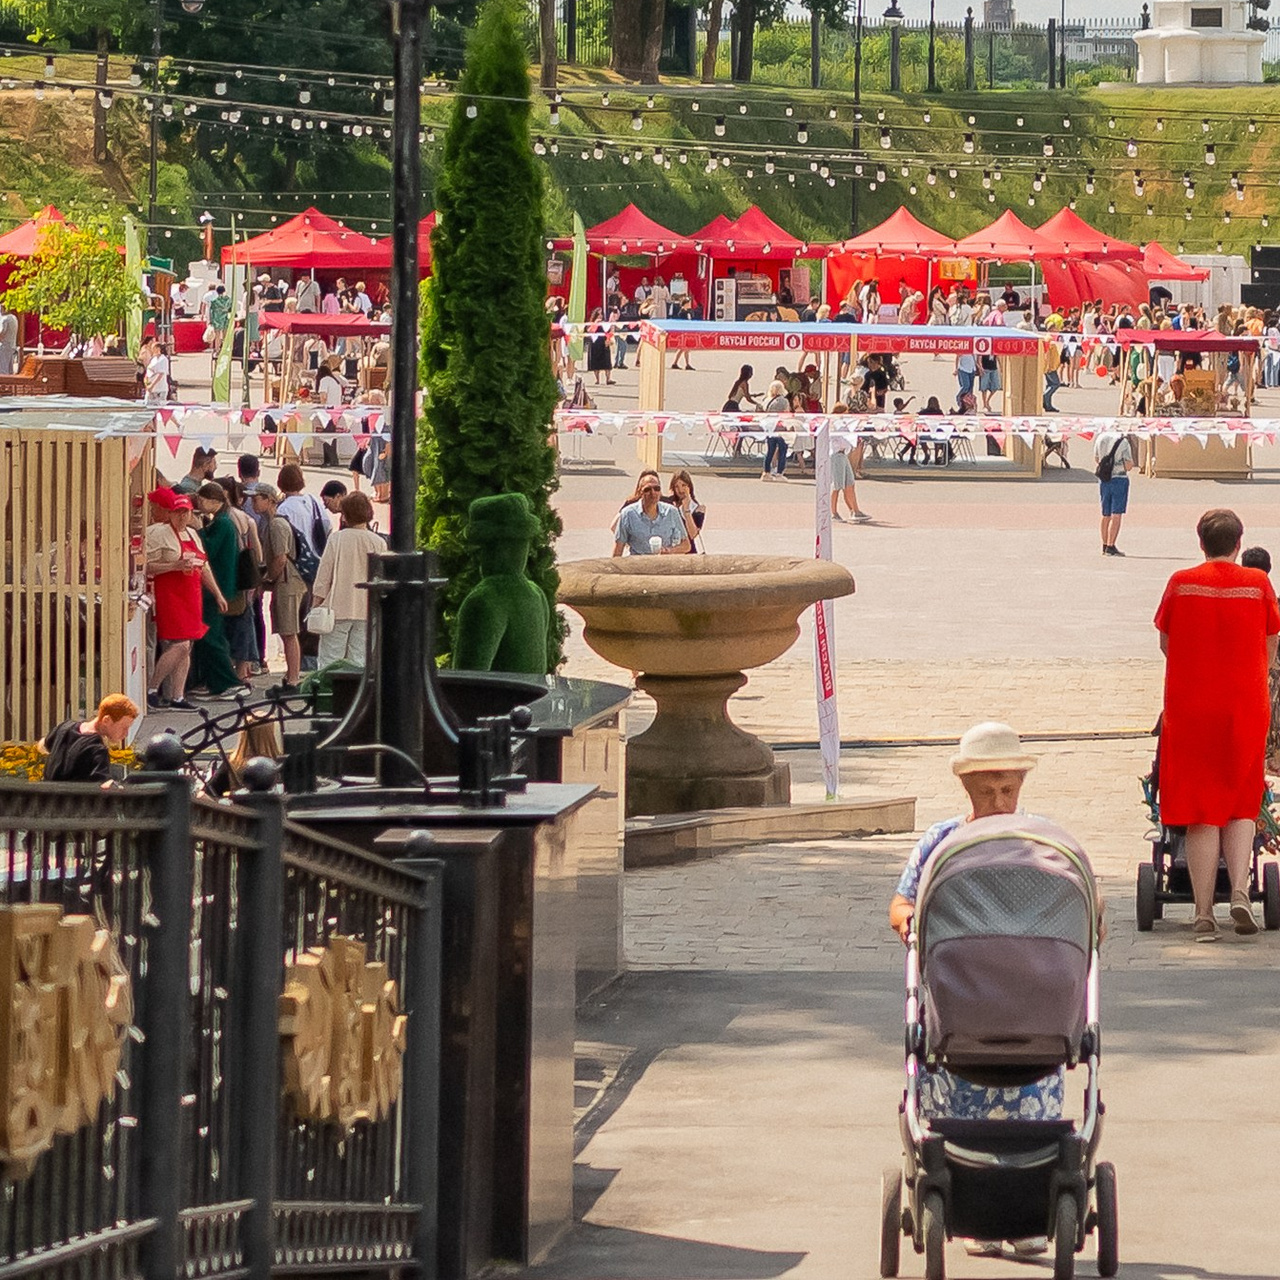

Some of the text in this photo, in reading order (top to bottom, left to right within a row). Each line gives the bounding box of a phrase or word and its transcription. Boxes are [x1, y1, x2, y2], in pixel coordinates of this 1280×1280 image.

[720, 335, 780, 347] ВКУСЫ РОССИИ
[910, 338, 969, 350] ВКУСЫ РОССИИ
